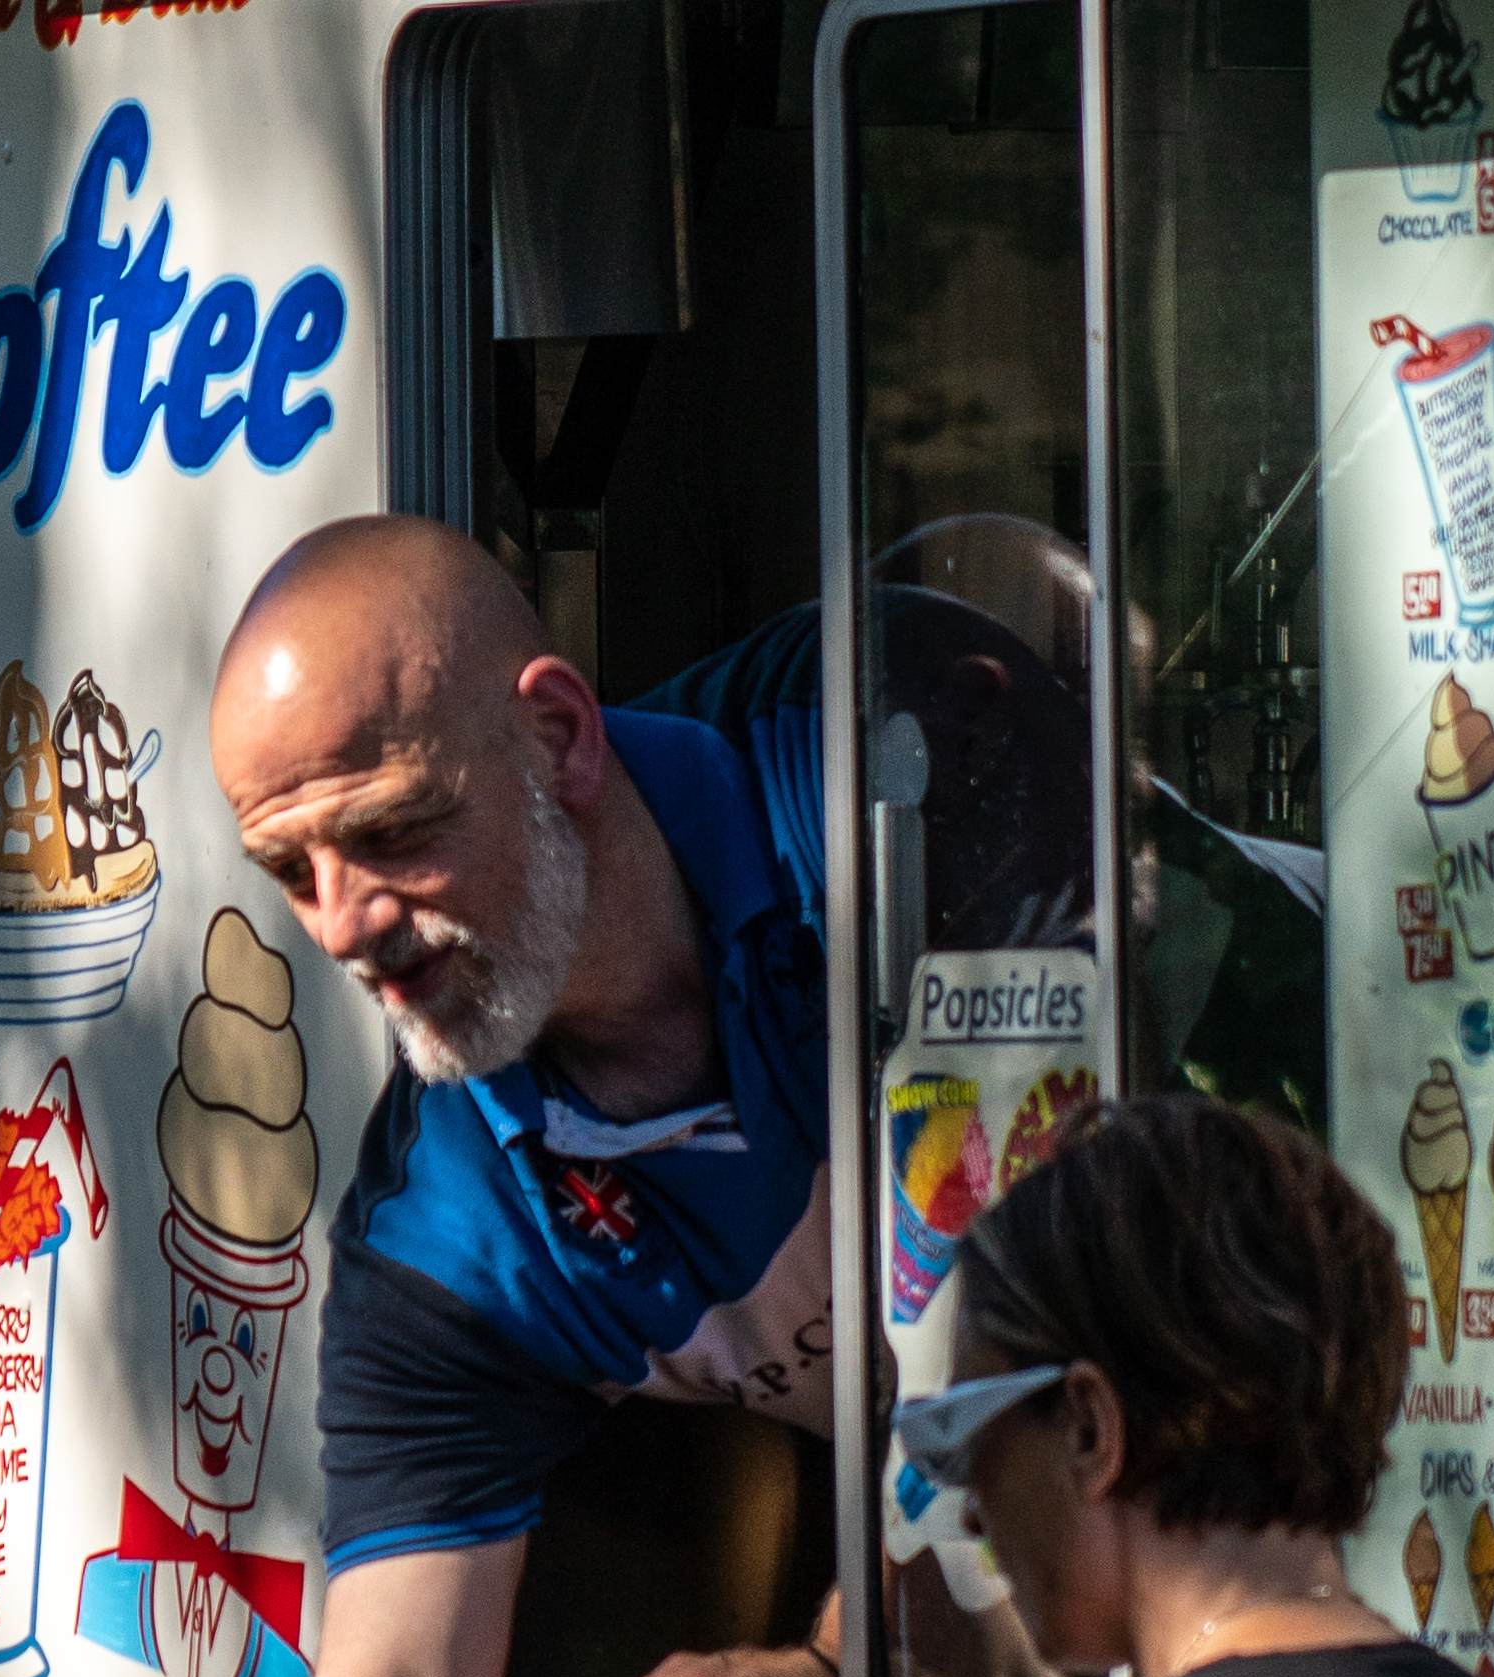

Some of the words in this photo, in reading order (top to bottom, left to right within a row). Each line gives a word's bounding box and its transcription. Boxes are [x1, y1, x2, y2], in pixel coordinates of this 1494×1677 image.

[1378, 209, 1473, 244] CHOCOLATE
[1408, 631, 1458, 663] MILK
[921, 967, 1086, 1042] Popsicles
[1420, 1452, 1476, 1497] DIPS
